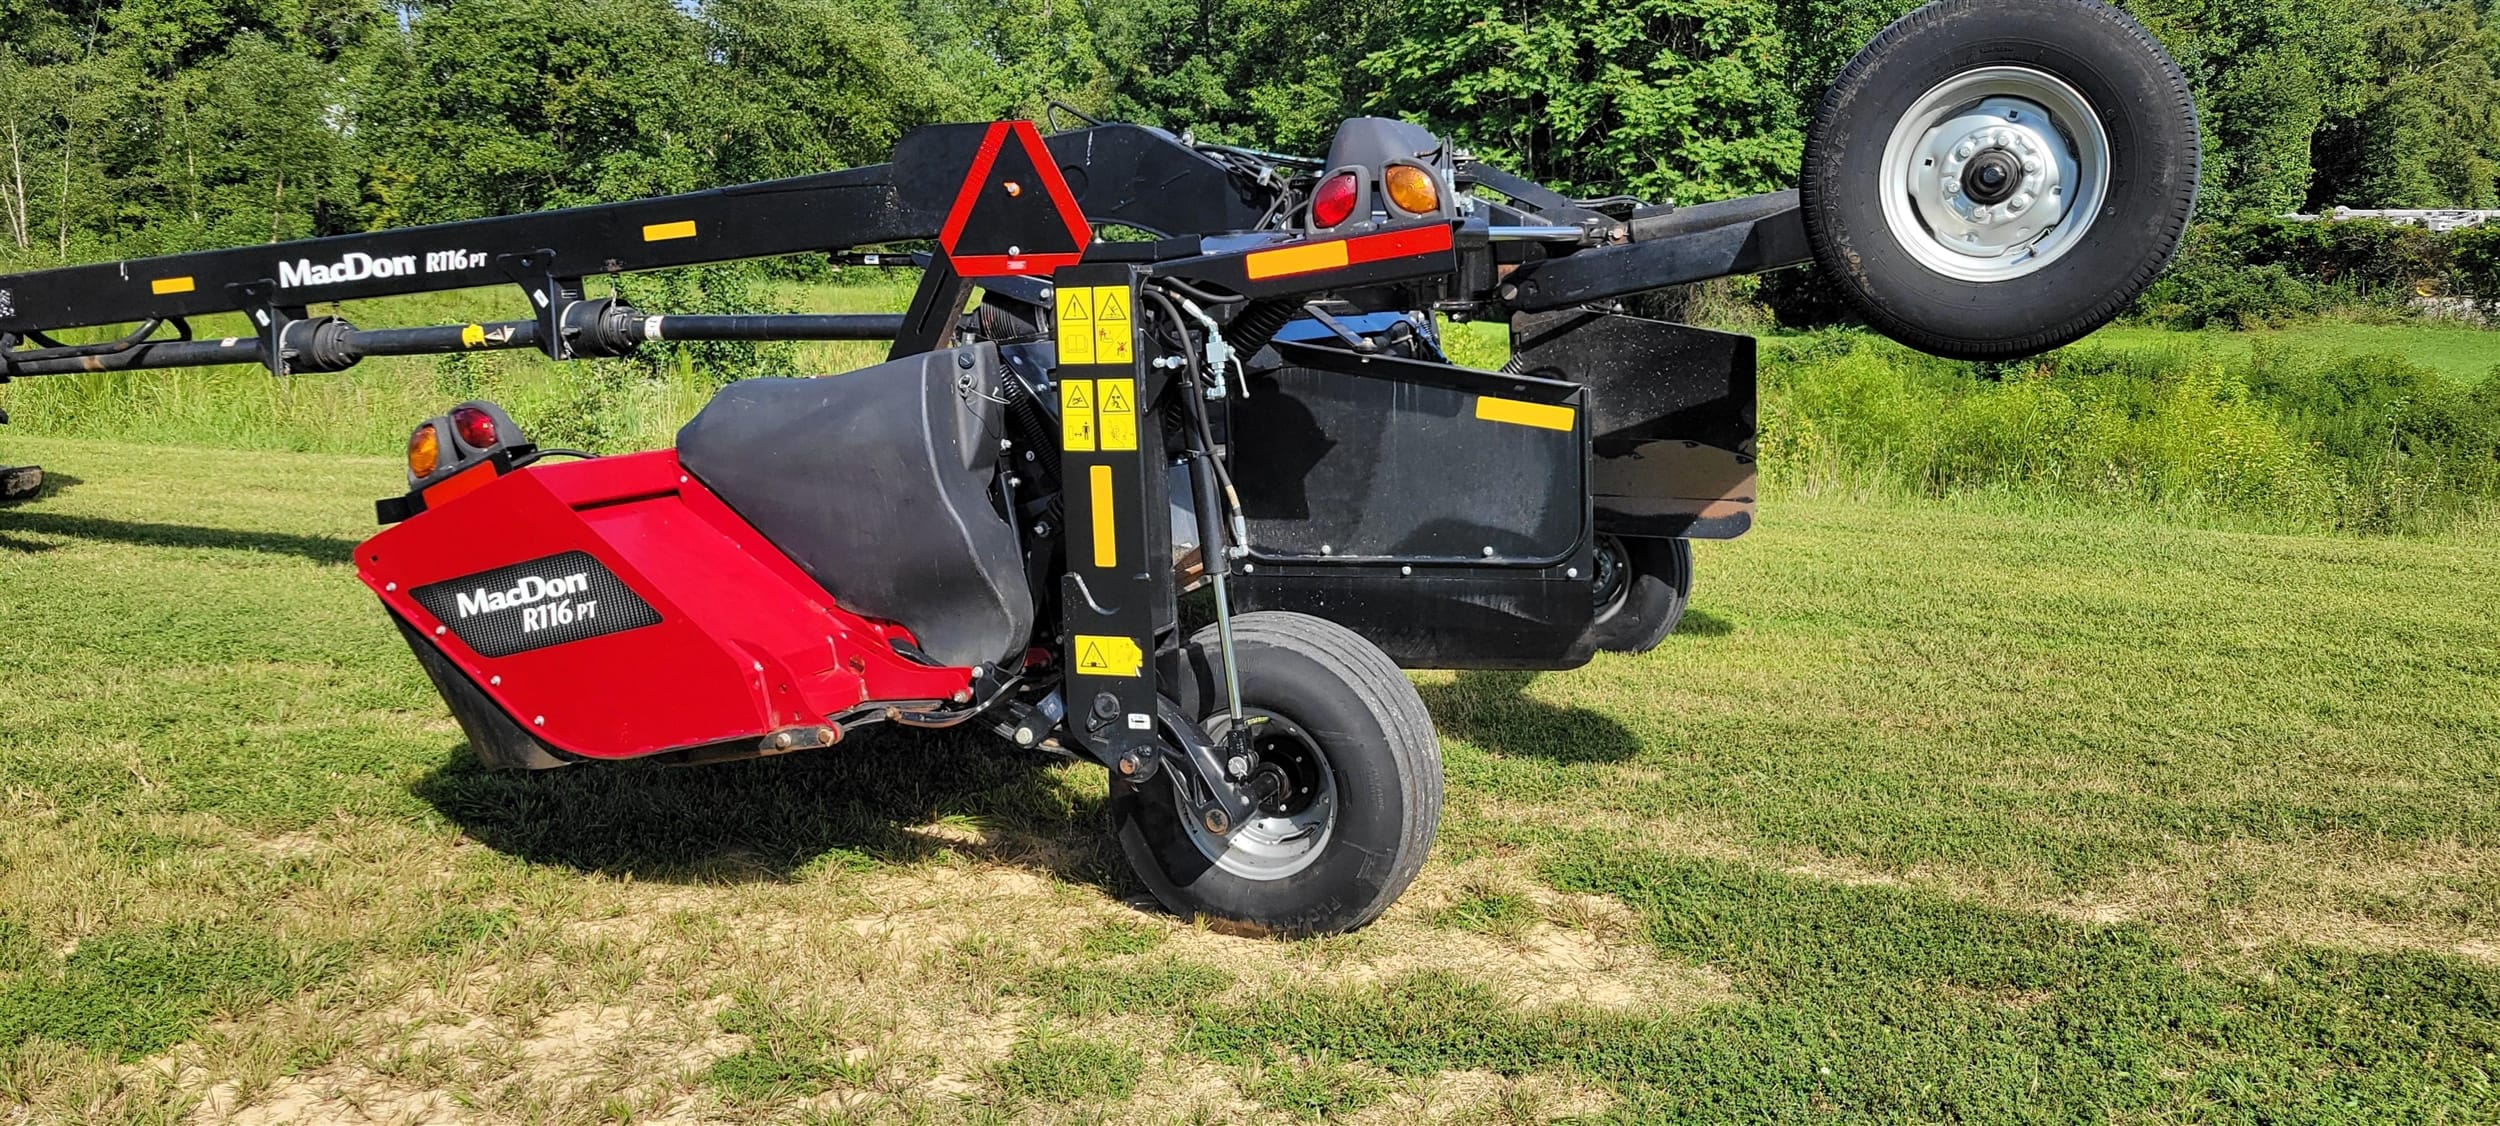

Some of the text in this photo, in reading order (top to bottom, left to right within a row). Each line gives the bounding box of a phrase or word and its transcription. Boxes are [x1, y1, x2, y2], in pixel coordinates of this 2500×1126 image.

[279, 249, 488, 288] MacDon R116 PT
[456, 573, 588, 618] MacDon
[523, 599, 597, 632] R116 PT
